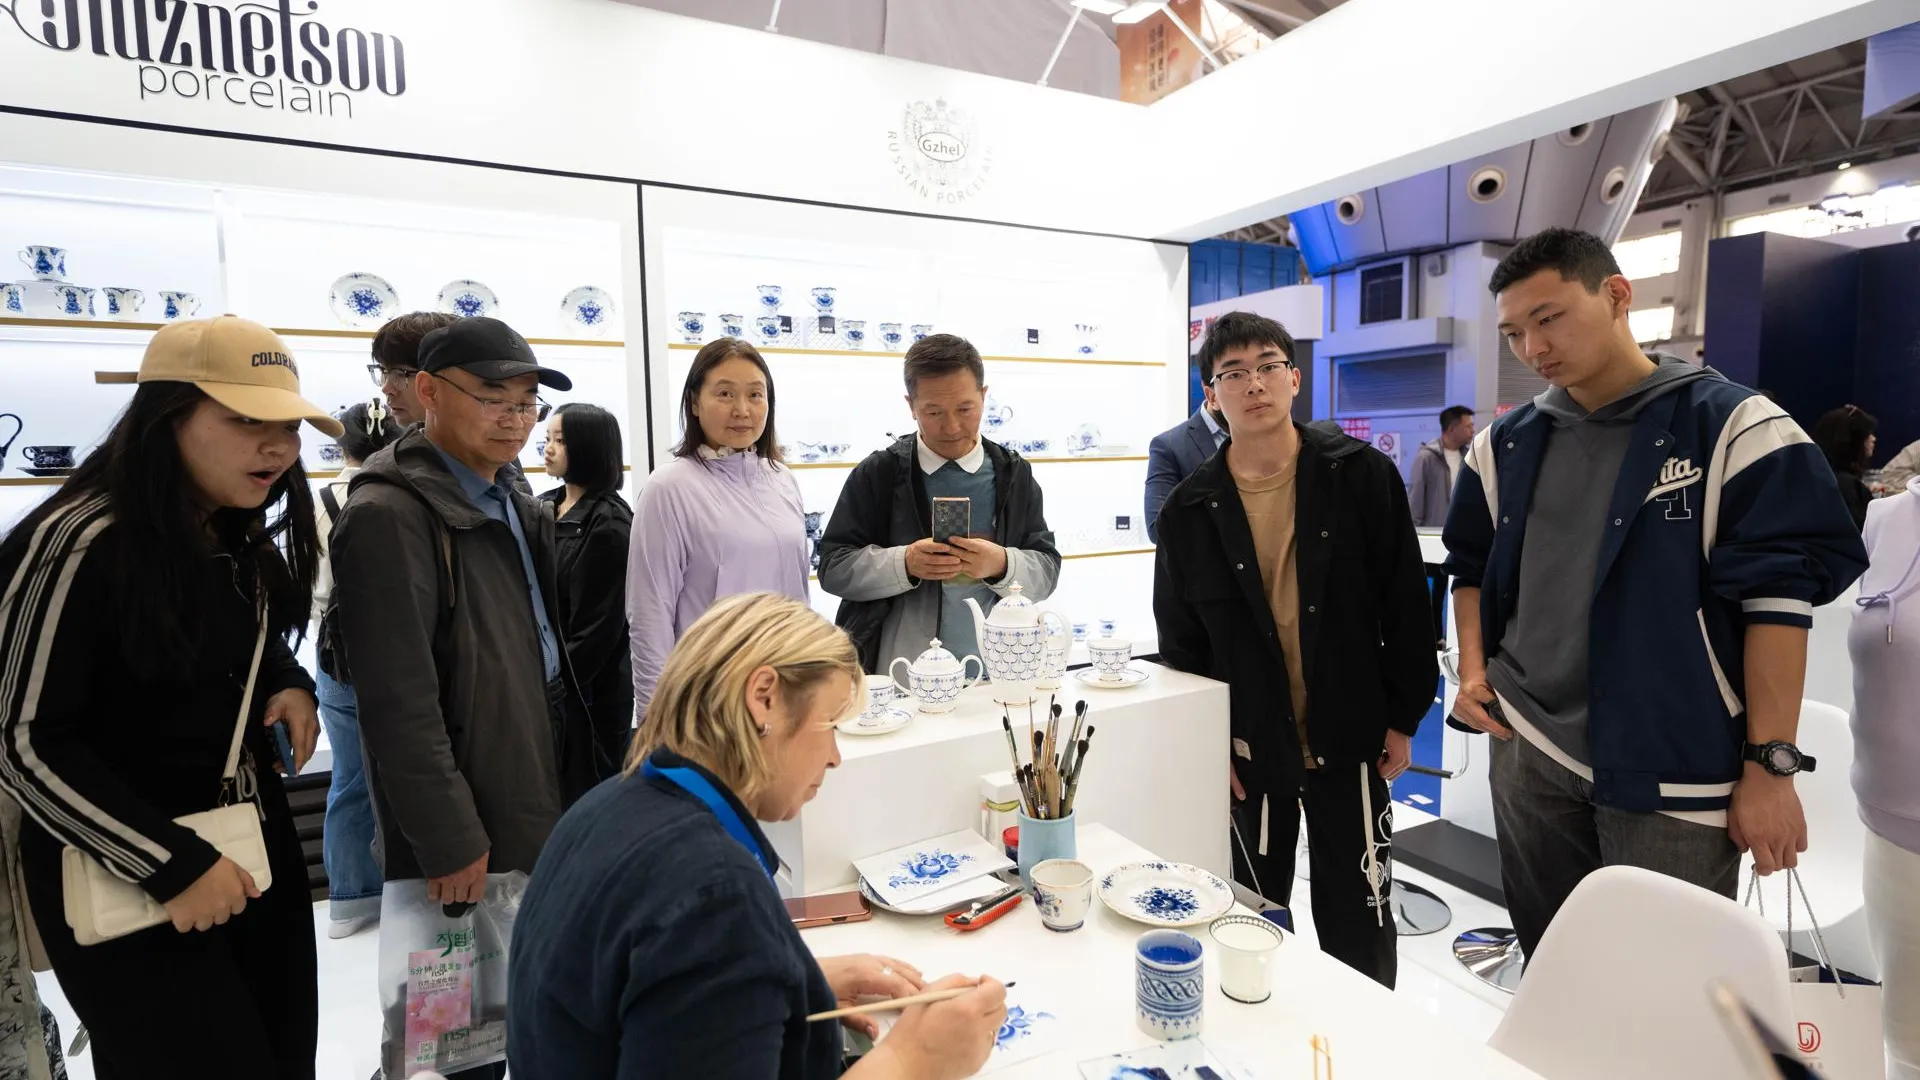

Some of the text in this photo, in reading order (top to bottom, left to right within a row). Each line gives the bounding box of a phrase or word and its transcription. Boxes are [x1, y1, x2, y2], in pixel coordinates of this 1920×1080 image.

[138, 63, 353, 119] porcelain
[887, 130, 929, 198] RUSSIAN
[922, 138, 960, 157] Gzhel
